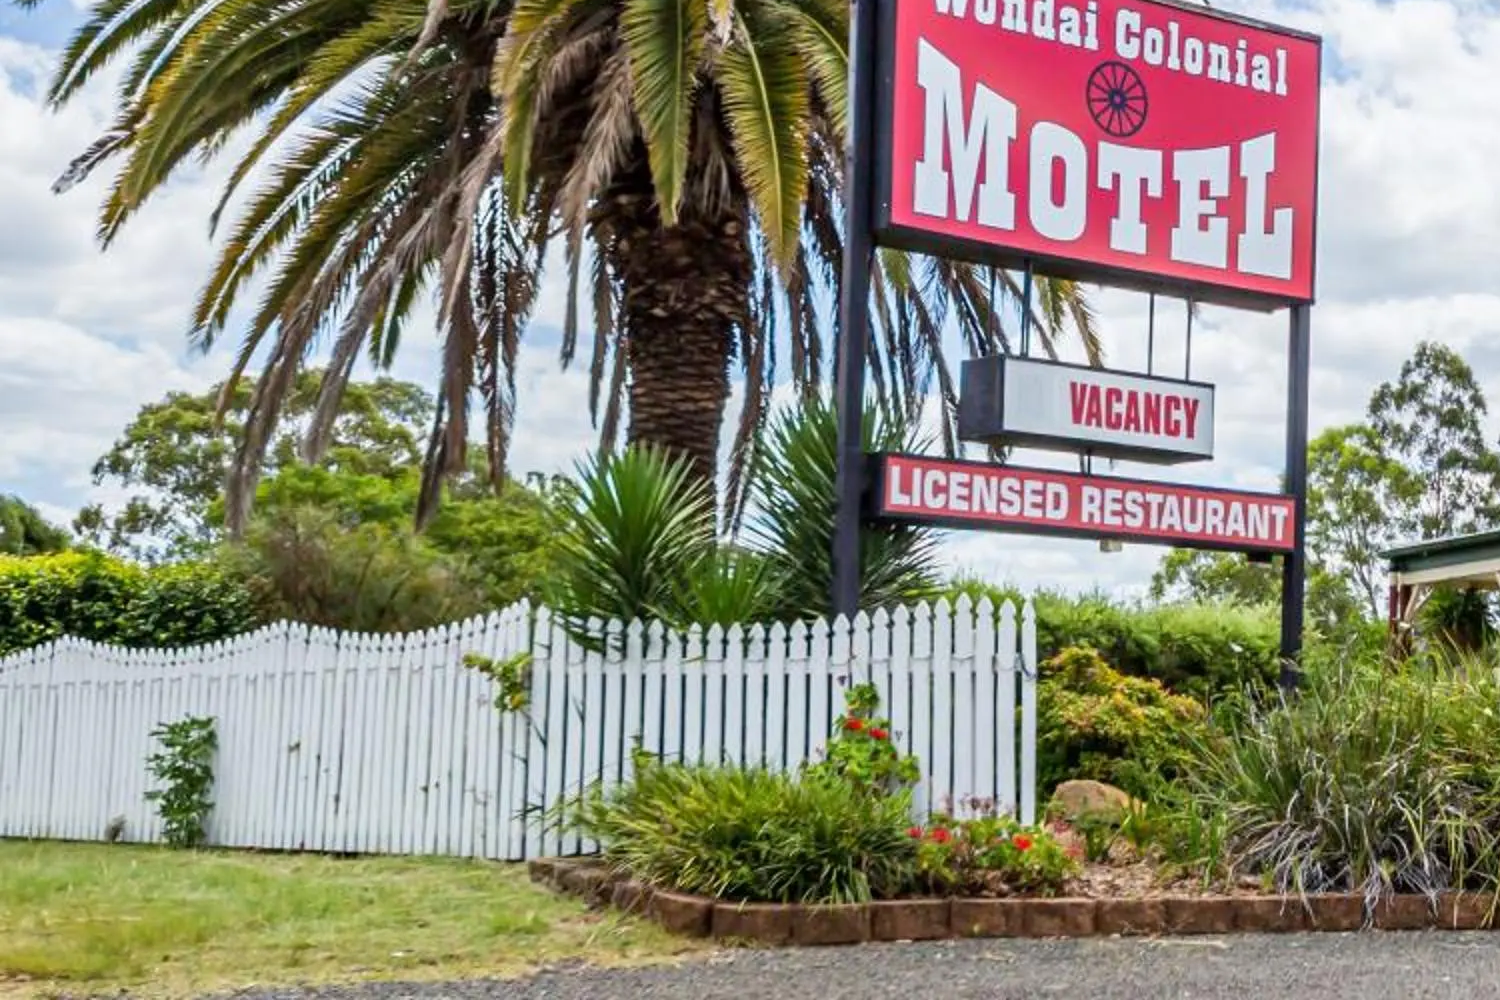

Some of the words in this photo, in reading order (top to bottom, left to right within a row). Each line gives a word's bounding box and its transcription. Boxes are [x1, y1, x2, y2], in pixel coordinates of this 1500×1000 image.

[1115, 9, 1288, 97] Colonial
[913, 36, 1294, 281] MOTEL
[1069, 381, 1199, 439] VACANCY
[889, 466, 1069, 521] LICENSED
[1081, 485, 1288, 542] RESTAURANT
